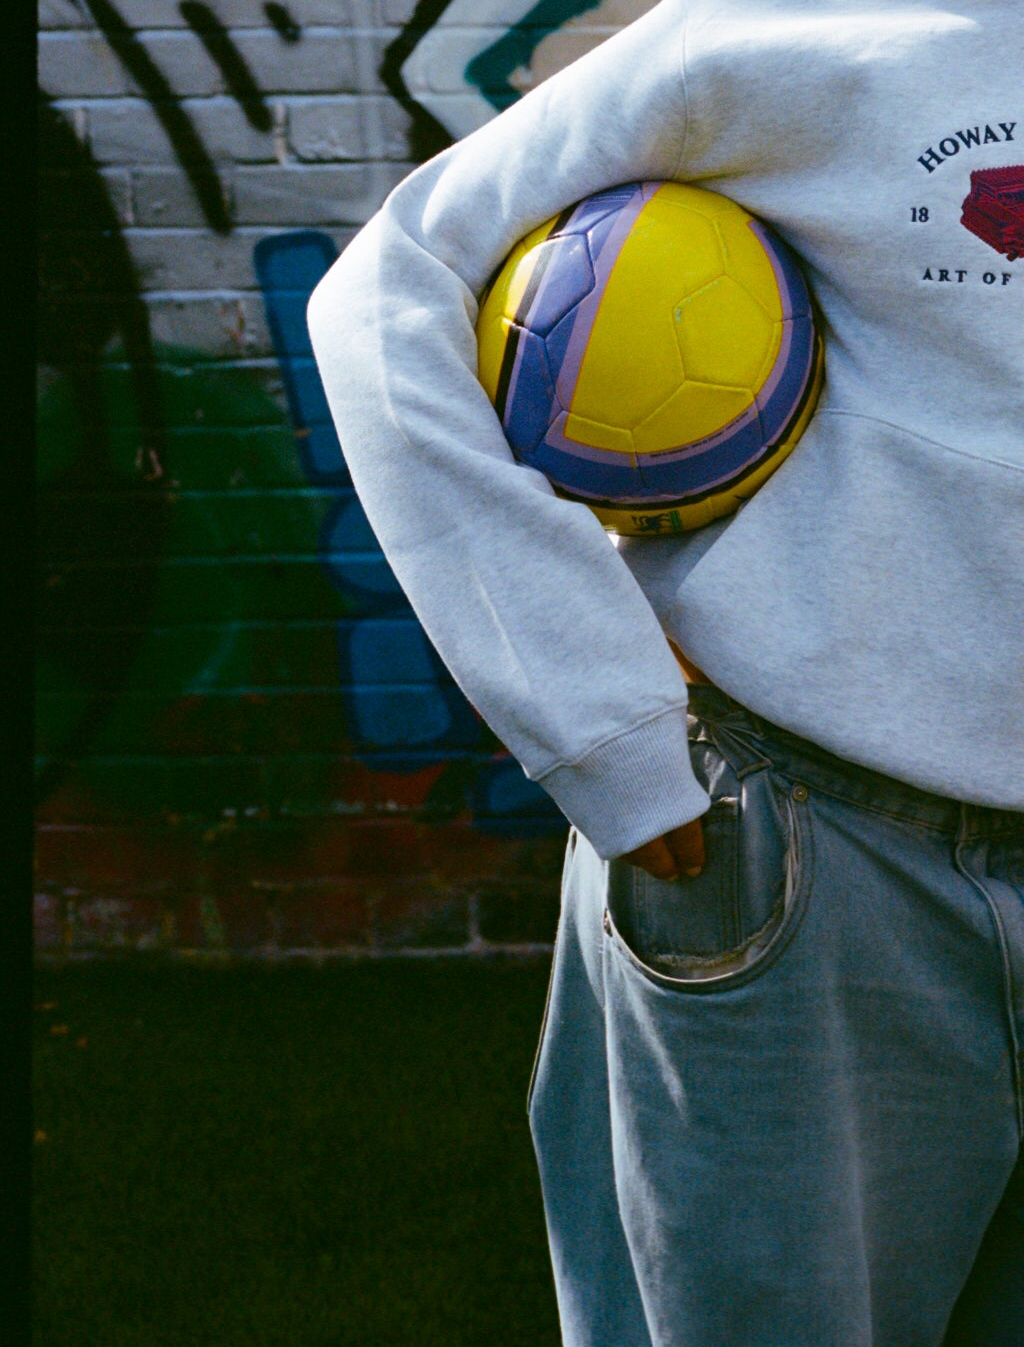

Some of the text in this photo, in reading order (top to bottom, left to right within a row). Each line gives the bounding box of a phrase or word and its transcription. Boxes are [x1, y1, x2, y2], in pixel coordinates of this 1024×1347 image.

[918, 123, 1016, 173] HOWAY
[911, 207, 929, 222] 18
[923, 268, 967, 282] ART
[983, 272, 1011, 285] OF
